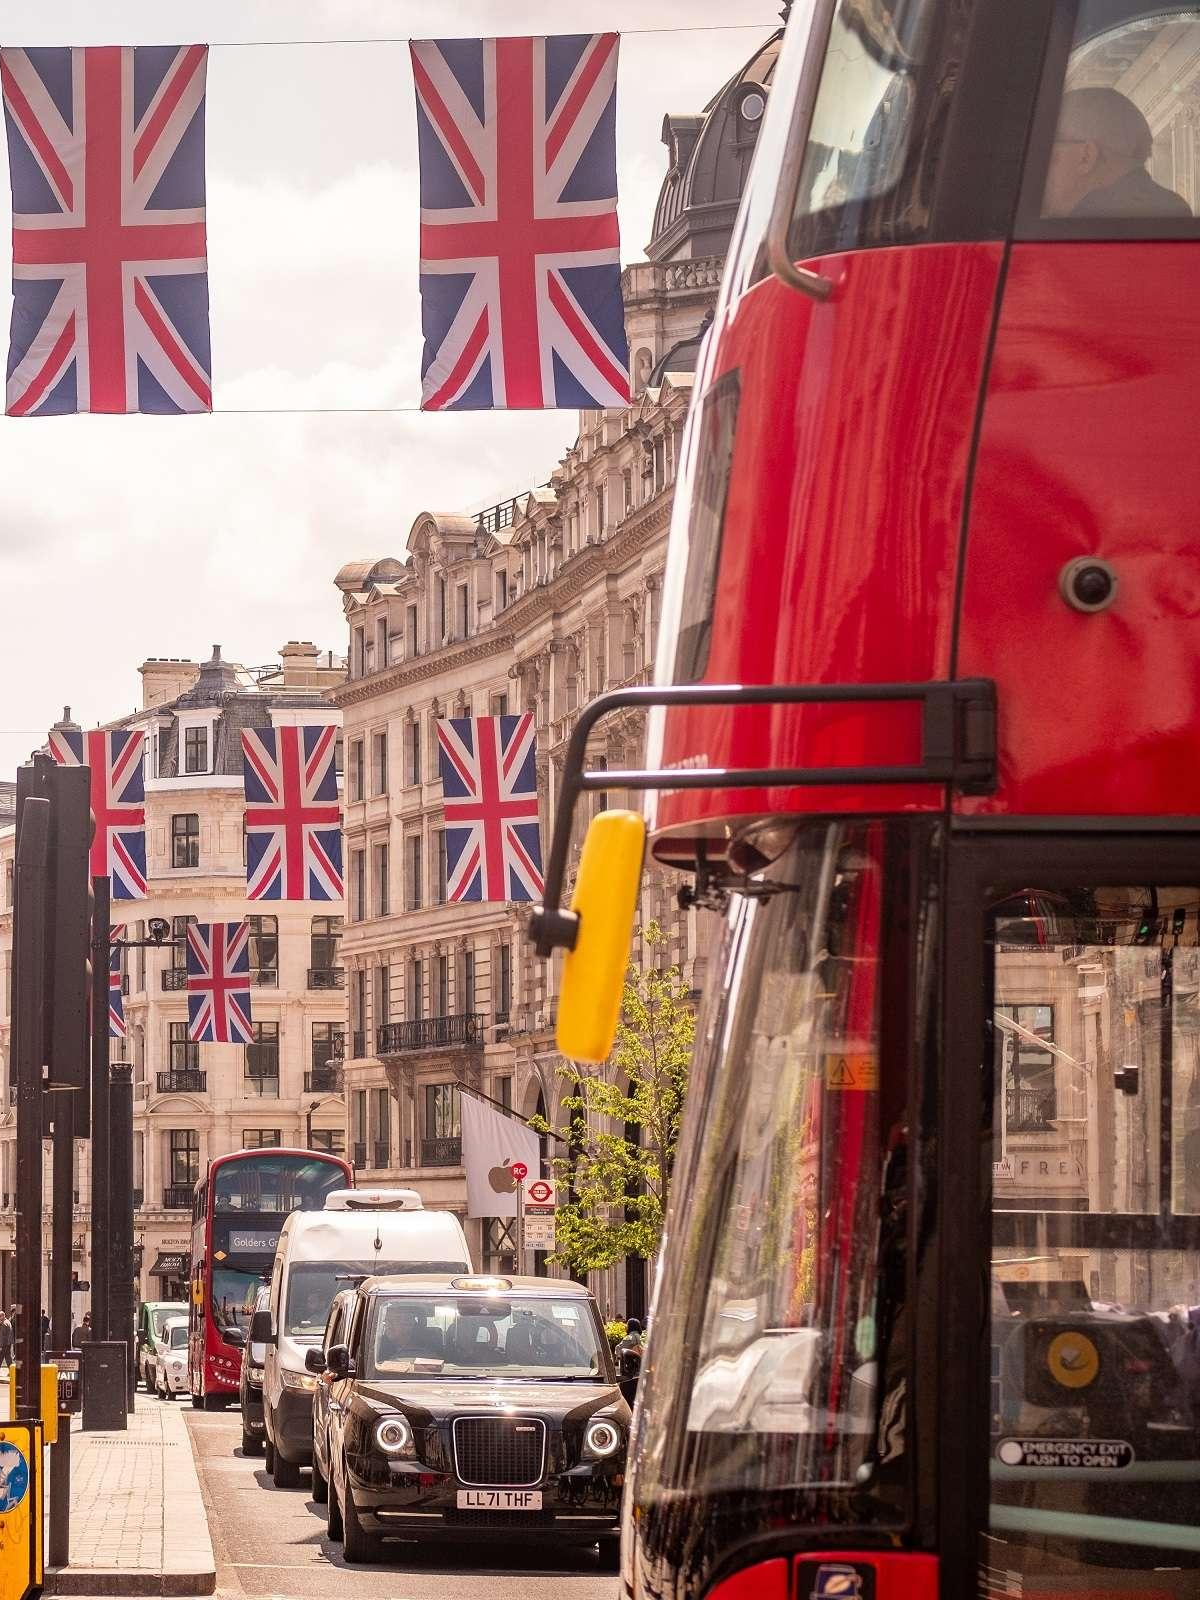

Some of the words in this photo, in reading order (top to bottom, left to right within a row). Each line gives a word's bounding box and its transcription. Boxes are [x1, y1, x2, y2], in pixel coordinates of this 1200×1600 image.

[233, 1237, 266, 1247] Golders
[1022, 1442, 1098, 1454] EMERGENCY
[1099, 1443, 1127, 1456] EXIT
[1025, 1454, 1060, 1466] PUSH
[1061, 1455, 1081, 1467] TO
[1082, 1455, 1118, 1467] OPEN
[466, 1491, 500, 1507] LL71
[504, 1492, 534, 1507] THF
